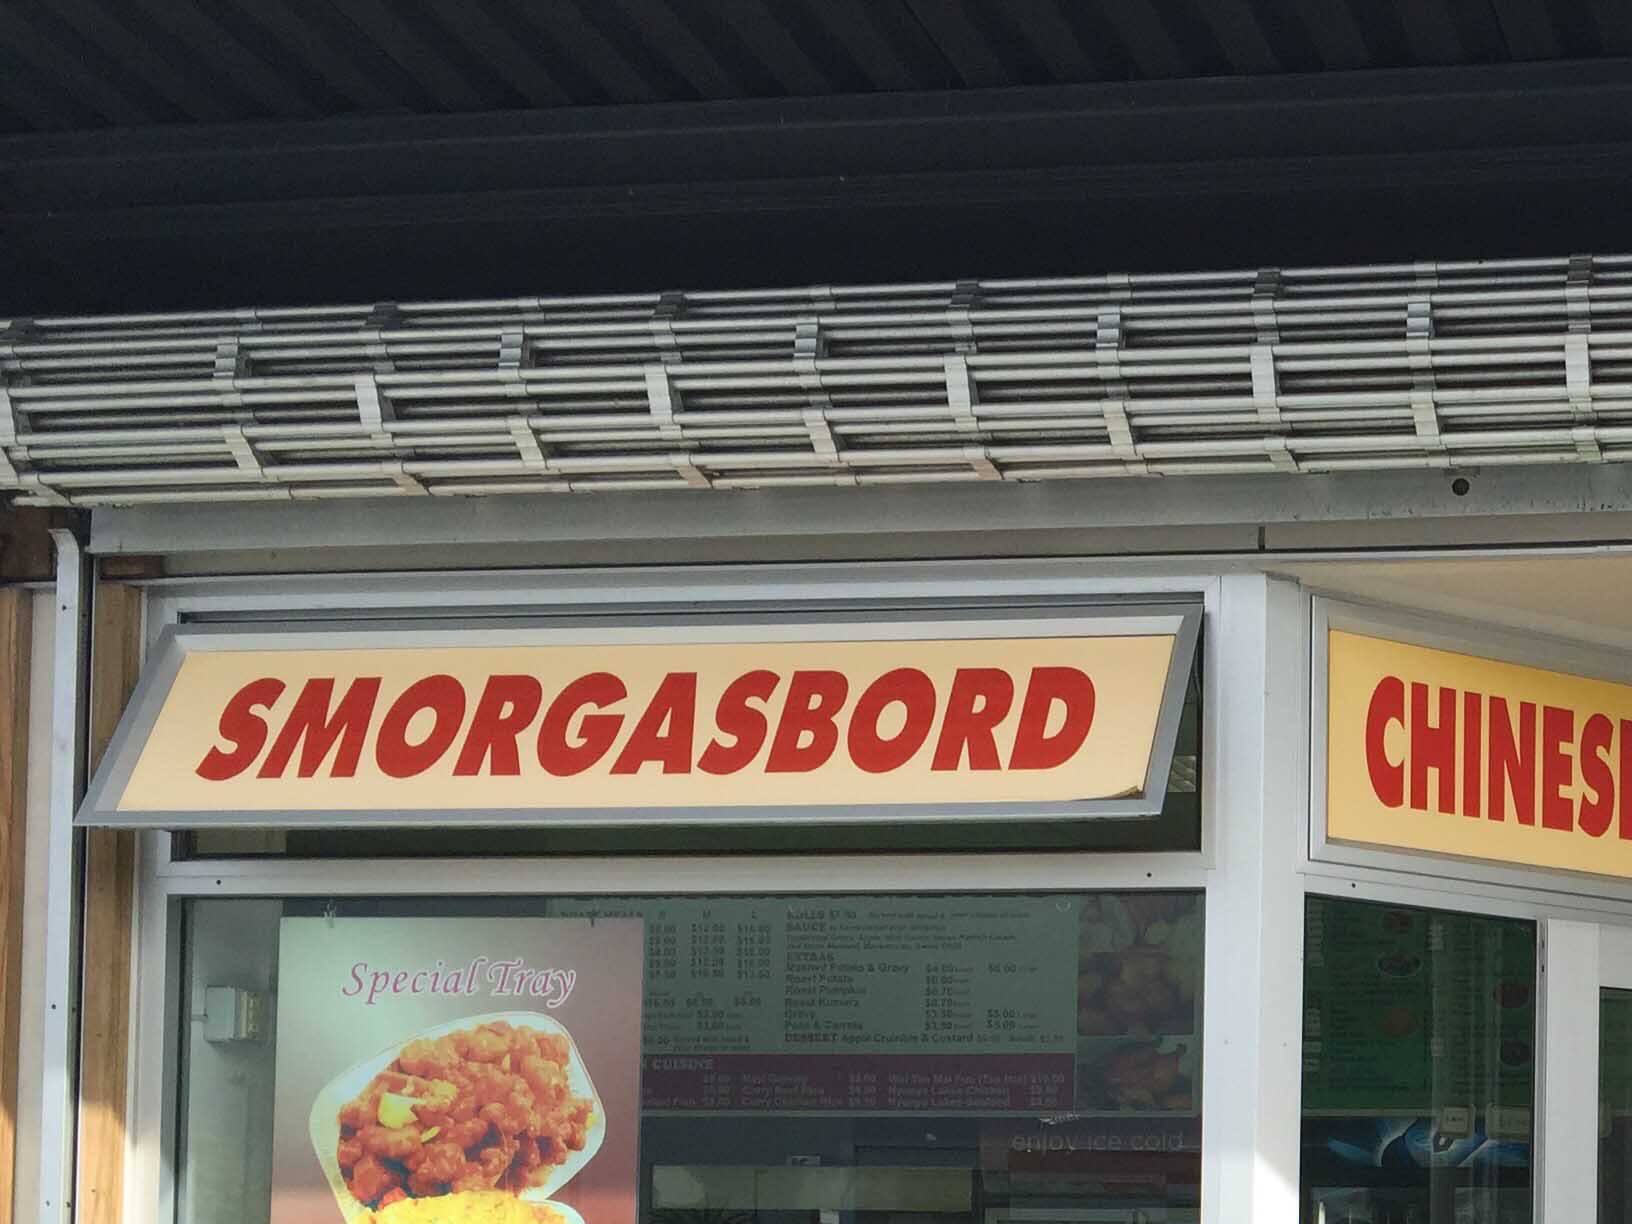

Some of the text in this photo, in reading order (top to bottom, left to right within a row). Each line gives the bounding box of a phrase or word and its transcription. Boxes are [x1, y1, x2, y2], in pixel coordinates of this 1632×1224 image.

[195, 666, 1097, 782] SMORGASBORD
[341, 956, 577, 1009] Special Tray
[1010, 1132, 1184, 1155] enjoy ice cold
